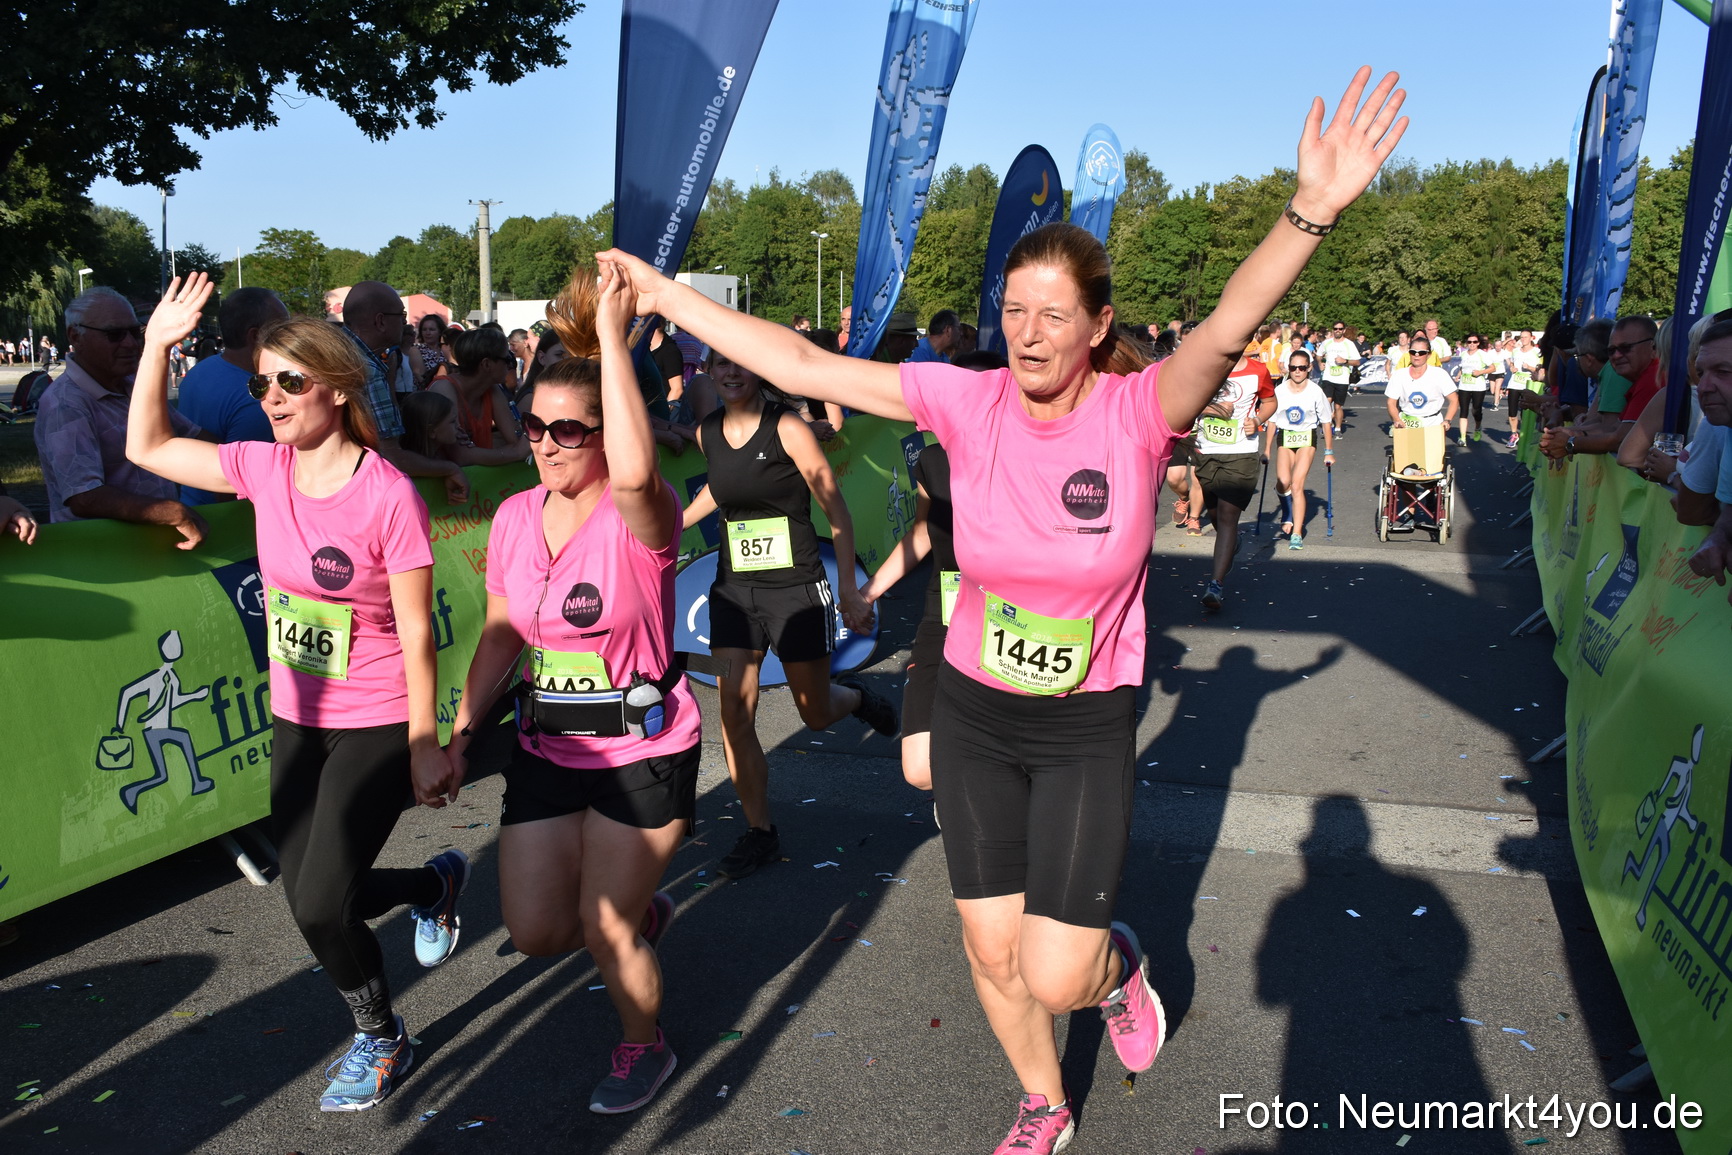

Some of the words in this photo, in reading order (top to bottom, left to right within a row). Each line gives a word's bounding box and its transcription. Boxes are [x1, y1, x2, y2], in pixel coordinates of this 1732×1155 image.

[1206, 424, 1233, 438] 1558
[1287, 433, 1309, 443] 2024
[429, 490, 494, 543] esunde
[740, 537, 774, 557] 857
[274, 617, 334, 657] 1446
[298, 651, 328, 665] Veronika
[993, 628, 1073, 674] 1445
[998, 658, 1029, 678] Schlenk
[1030, 672, 1059, 684] Margit
[1651, 918, 1729, 1022] neumarkt
